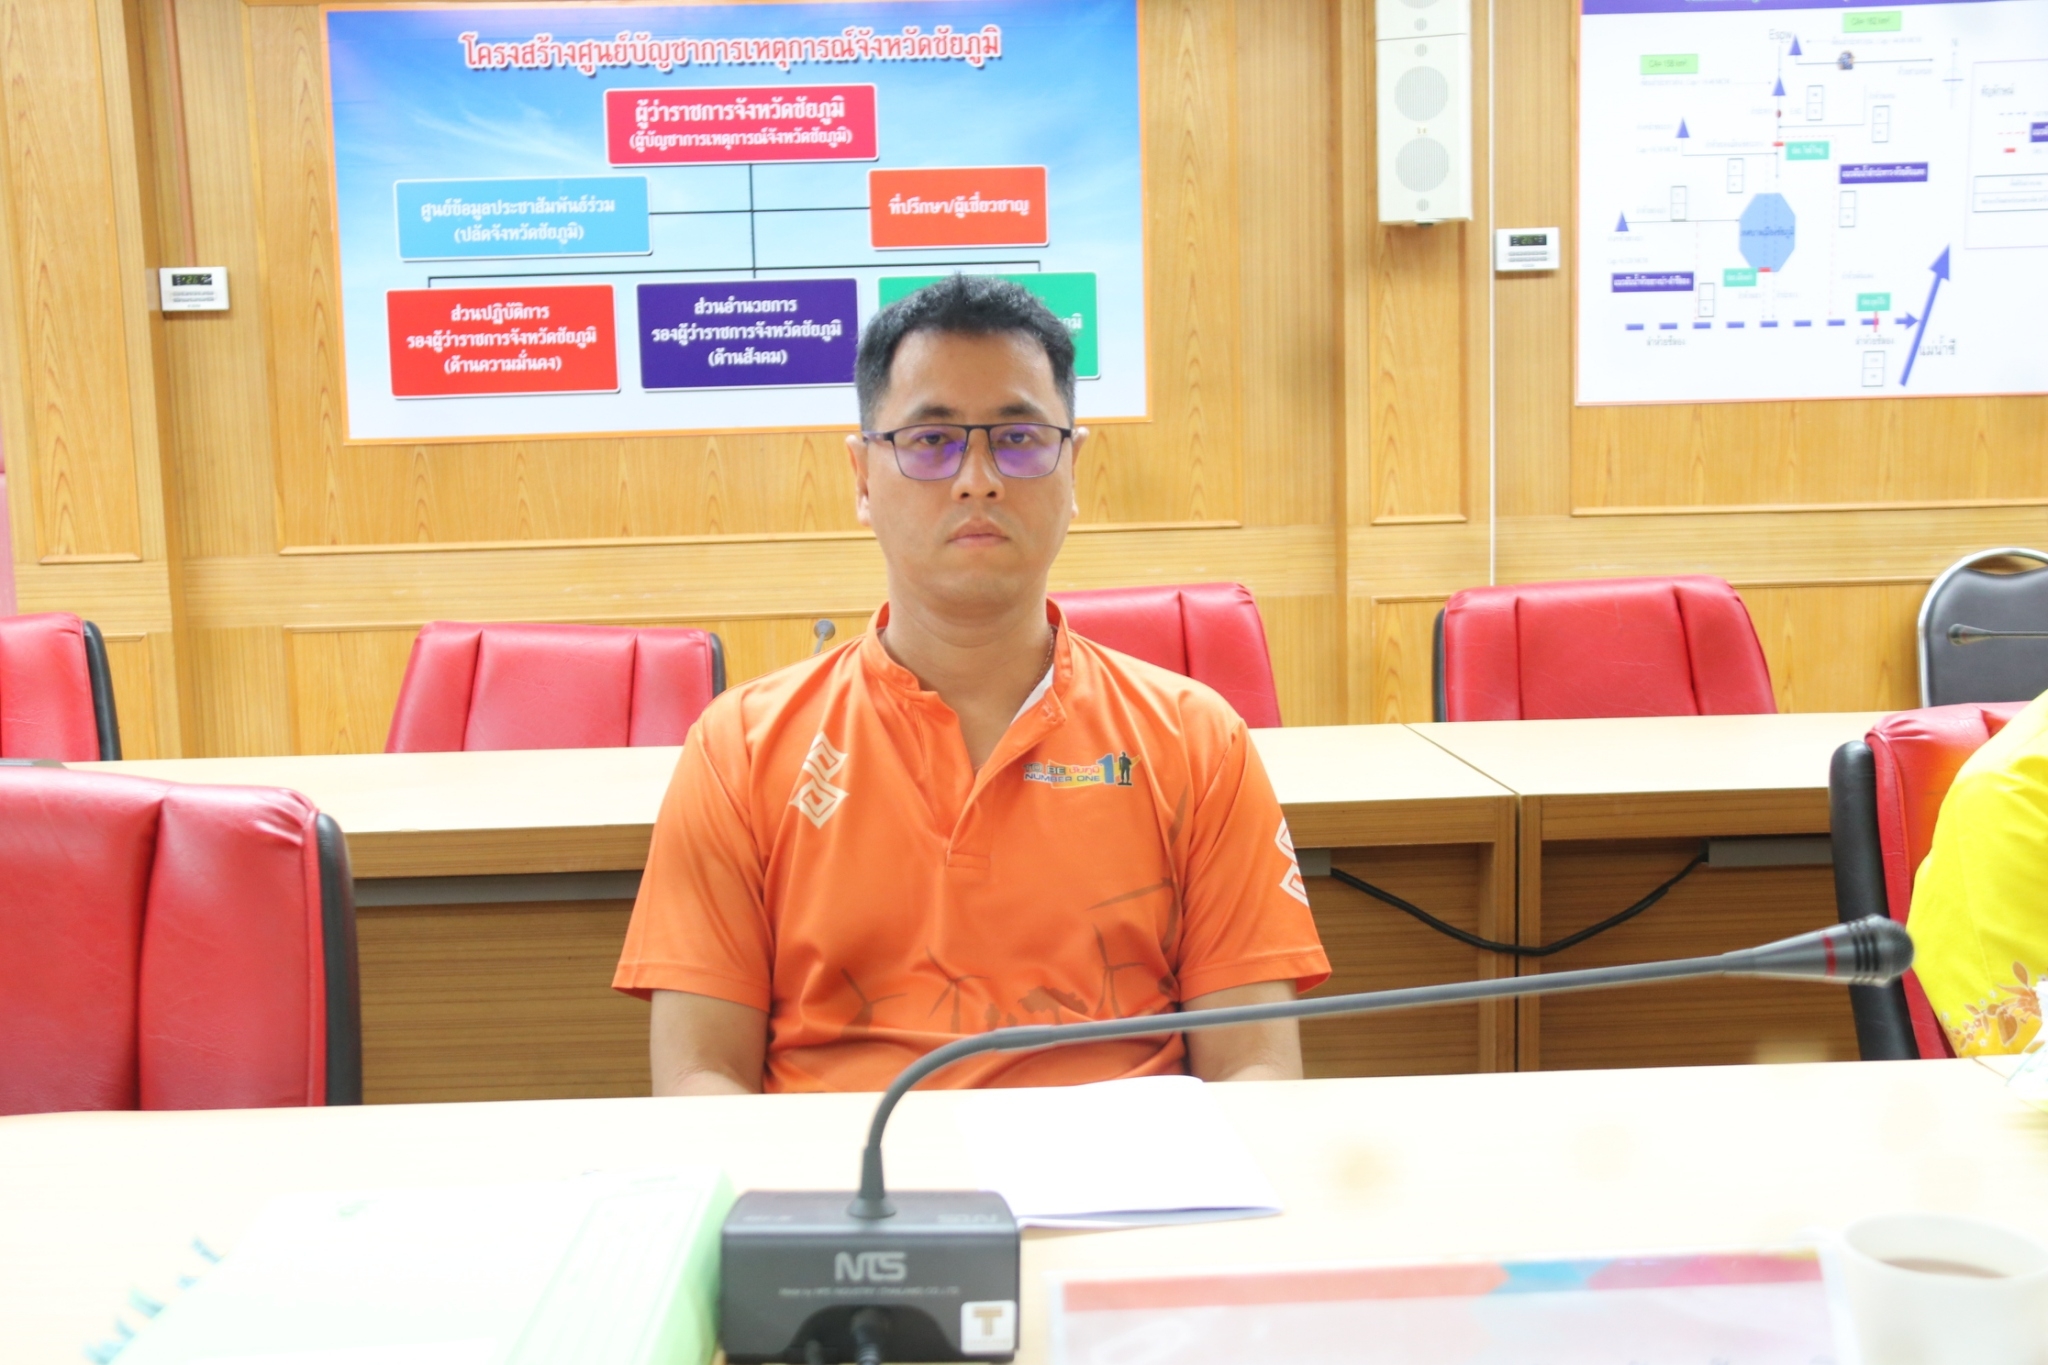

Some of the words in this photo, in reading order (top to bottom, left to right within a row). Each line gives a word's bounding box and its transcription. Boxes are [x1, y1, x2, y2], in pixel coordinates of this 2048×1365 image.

[461, 25, 1001, 73] โครงสร้างศูนย์บัญชาการเหตุการณ์จังหวัดชัยภูมิ
[635, 95, 845, 129] ผู้ว่าราชการจังหวัดชัยภูมิ
[629, 126, 853, 152] (ผู้บัญชาการเหตุการณ์จังหวัดชัยภูมิ)
[421, 194, 615, 222] ศูนย์ข้อมูลประชาสัมพันธ์ร่วม
[888, 192, 1030, 219] ที่ปรึกษา/ผู้เชี่ยวชาญ
[454, 221, 584, 244] (ปลัดจังหวัดชัยภูมิ)
[450, 302, 550, 324] ส่วนปฏิบัติการ
[694, 296, 798, 316] ส่วนอำนวยการ
[406, 326, 597, 353] รองผู้ว่าราชการจังหวัดชัยภูมิ
[651, 319, 842, 346] รองผู้ว่าราชการจังหวัดชัยภูมิ
[444, 350, 562, 375] (ด้านความมั่นคง)
[708, 347, 788, 367] (ด้านสังคม)
[1025, 773, 1072, 783] NUMBER
[1047, 766, 1066, 775] BE
[972, 1306, 1003, 1337] T
